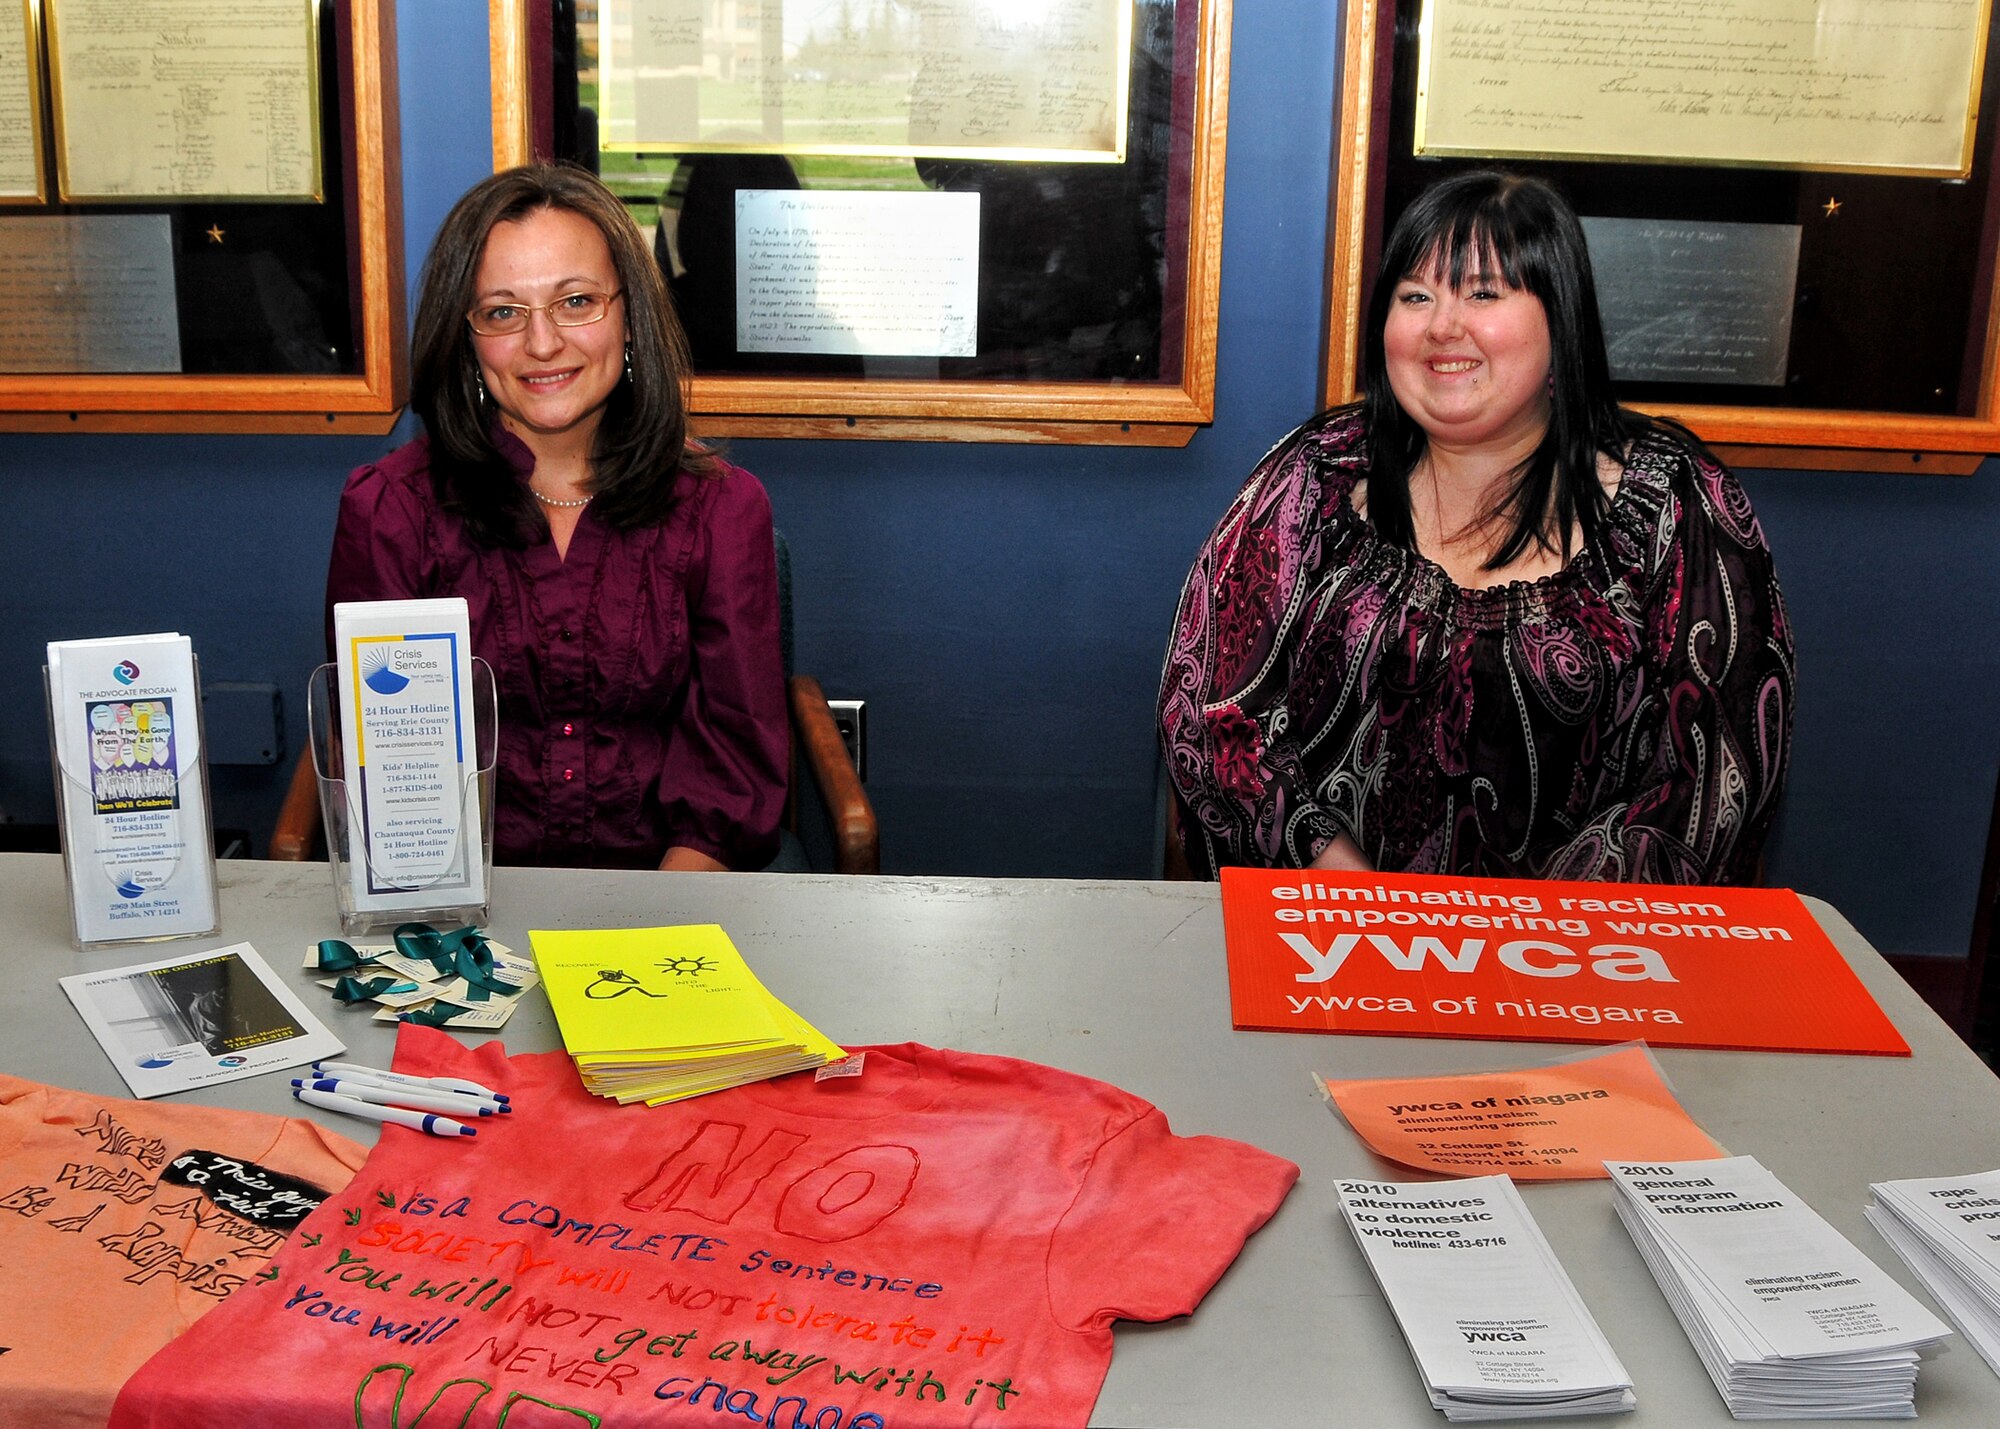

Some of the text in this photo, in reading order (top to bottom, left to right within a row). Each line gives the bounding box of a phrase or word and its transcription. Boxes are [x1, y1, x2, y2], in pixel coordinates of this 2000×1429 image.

[394, 649, 422, 660] Crisis
[395, 661, 438, 671] Services
[95, 689, 137, 698] ADVOCATE
[139, 687, 177, 696] PROGRAM
[365, 704, 450, 716] 24 Hour Hotline
[366, 717, 449, 728] Serving Erie County
[120, 728, 149, 737] They're
[374, 726, 443, 738] 716-834-3131
[375, 741, 444, 750] www.crisisservices.org
[405, 762, 440, 771] Helpline
[387, 773, 437, 782] 716-834-1144
[382, 784, 443, 794] 1-877-KIDS-400
[96, 799, 173, 811] Then We'll Celebrate
[140, 814, 170, 822] Hotline
[386, 817, 443, 827] also servicing
[113, 823, 163, 832] 716-834-3131
[374, 828, 456, 839] Chautauqua County
[395, 841, 415, 849] Hour
[418, 839, 448, 847] Hotline
[388, 850, 444, 860] 1-800-724-0461
[153, 900, 178, 908] Street
[1271, 883, 1727, 918] eliminating racism
[109, 909, 181, 920] Buffalo, NY 14214
[1273, 905, 1794, 942] empowering women
[1276, 932, 1680, 984] ywca
[120, 973, 144, 981] NOT
[145, 967, 171, 976] THE
[171, 961, 203, 973] ONLY
[1286, 993, 1684, 1025] ywca of niagara
[234, 1034, 258, 1043] Hour
[260, 1026, 292, 1037] Hotline
[205, 1066, 248, 1079] ADVOCATE
[249, 1056, 290, 1069] PROGRAM
[1387, 1089, 1610, 1116] ywca of niagara
[1397, 1109, 1539, 1124] eliminating racism
[1403, 1118, 1557, 1134] empowering women
[1441, 1142, 1502, 1150] Cottage
[1506, 1140, 1529, 1148] St.
[1423, 1147, 1579, 1160] Lockport, NY 14094
[1431, 1157, 1562, 1166] 433-6714 ext. 19
[208, 1156, 275, 1191] This
[1619, 1165, 1674, 1177] 2010
[622, 1120, 920, 1244] NO
[1632, 1177, 1715, 1191] general
[1340, 1183, 1398, 1196] 2010
[1929, 1188, 1978, 1198] rape
[1349, 1197, 1486, 1210] alternatives
[1645, 1190, 1738, 1204] program
[1655, 1198, 1784, 1216] information
[1354, 1210, 1494, 1225] to domestic
[400, 1192, 439, 1217] is
[498, 1200, 729, 1262] COMPLETE
[1360, 1227, 1461, 1239] violence
[1392, 1236, 1507, 1249] hotline: 433-6716
[97, 1221, 248, 1303] Rapis
[1745, 1270, 1843, 1286] eliminating racism
[358, 1222, 1005, 1357] SOCIETY will NOT tolerate it
[1753, 1277, 1861, 1295] empowering women
[1805, 1307, 1830, 1316] YWCA
[1840, 1302, 1876, 1312] NIAGARA
[409, 1277, 512, 1312] will
[507, 1296, 621, 1338] NOT
[594, 1327, 698, 1363] get
[709, 1340, 827, 1385] away
[834, 1364, 947, 1403] with
[965, 1377, 1021, 1410] it
[1461, 1331, 1527, 1343] ywca
[369, 1315, 459, 1346] will
[464, 1337, 640, 1396] NEVER
